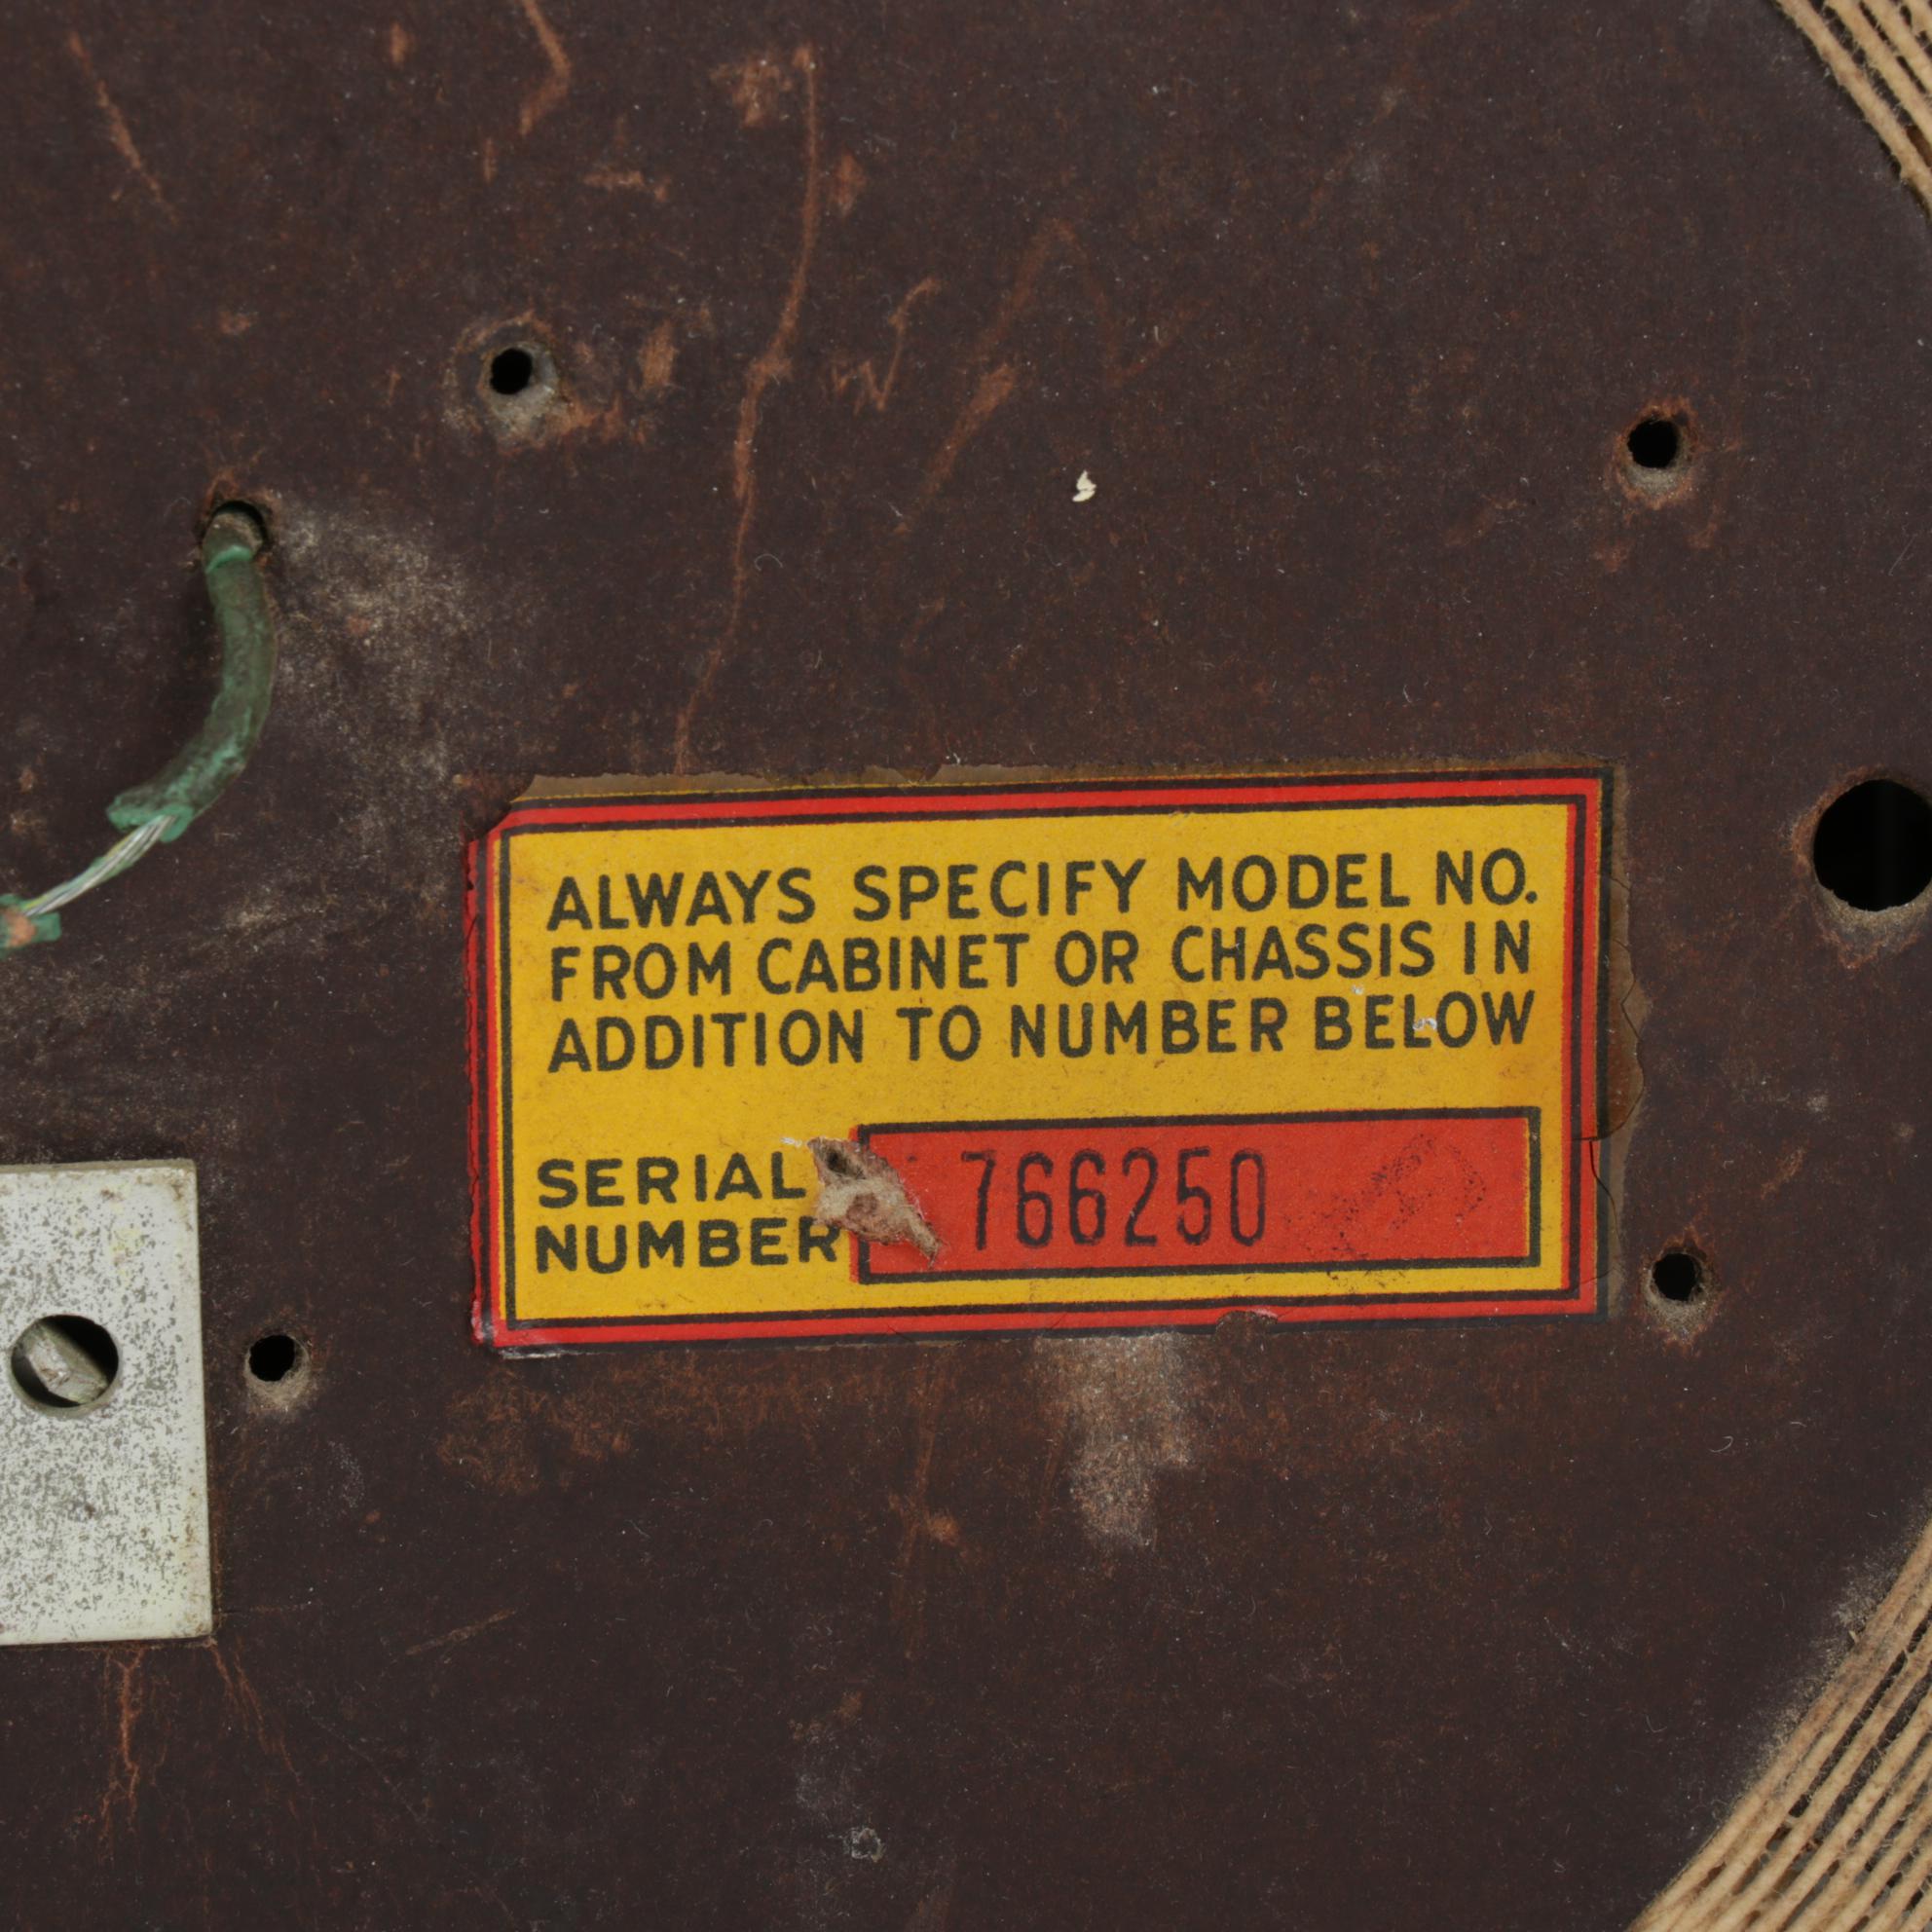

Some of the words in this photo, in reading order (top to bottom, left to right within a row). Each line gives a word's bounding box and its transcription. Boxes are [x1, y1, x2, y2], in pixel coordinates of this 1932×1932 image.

[547, 868, 815, 931] ALWAYS
[854, 860, 1145, 921] SPECIFY
[1178, 853, 1410, 911] MODEL
[1436, 848, 1538, 906] NO.
[552, 942, 730, 1001] FROM
[758, 933, 1029, 994] CABINET
[1056, 930, 1138, 986] OR
[1172, 920, 1434, 983] CHASSIS
[1465, 920, 1530, 975] IN
[548, 1010, 863, 1072] ADDITION
[897, 1005, 981, 1061] TO
[1011, 997, 1287, 1058] NUMBER
[1315, 990, 1535, 1050] BELOW
[539, 1152, 806, 1208] SERIAL
[961, 1146, 1266, 1250] 766250
[536, 1215, 841, 1274] NUMBER
